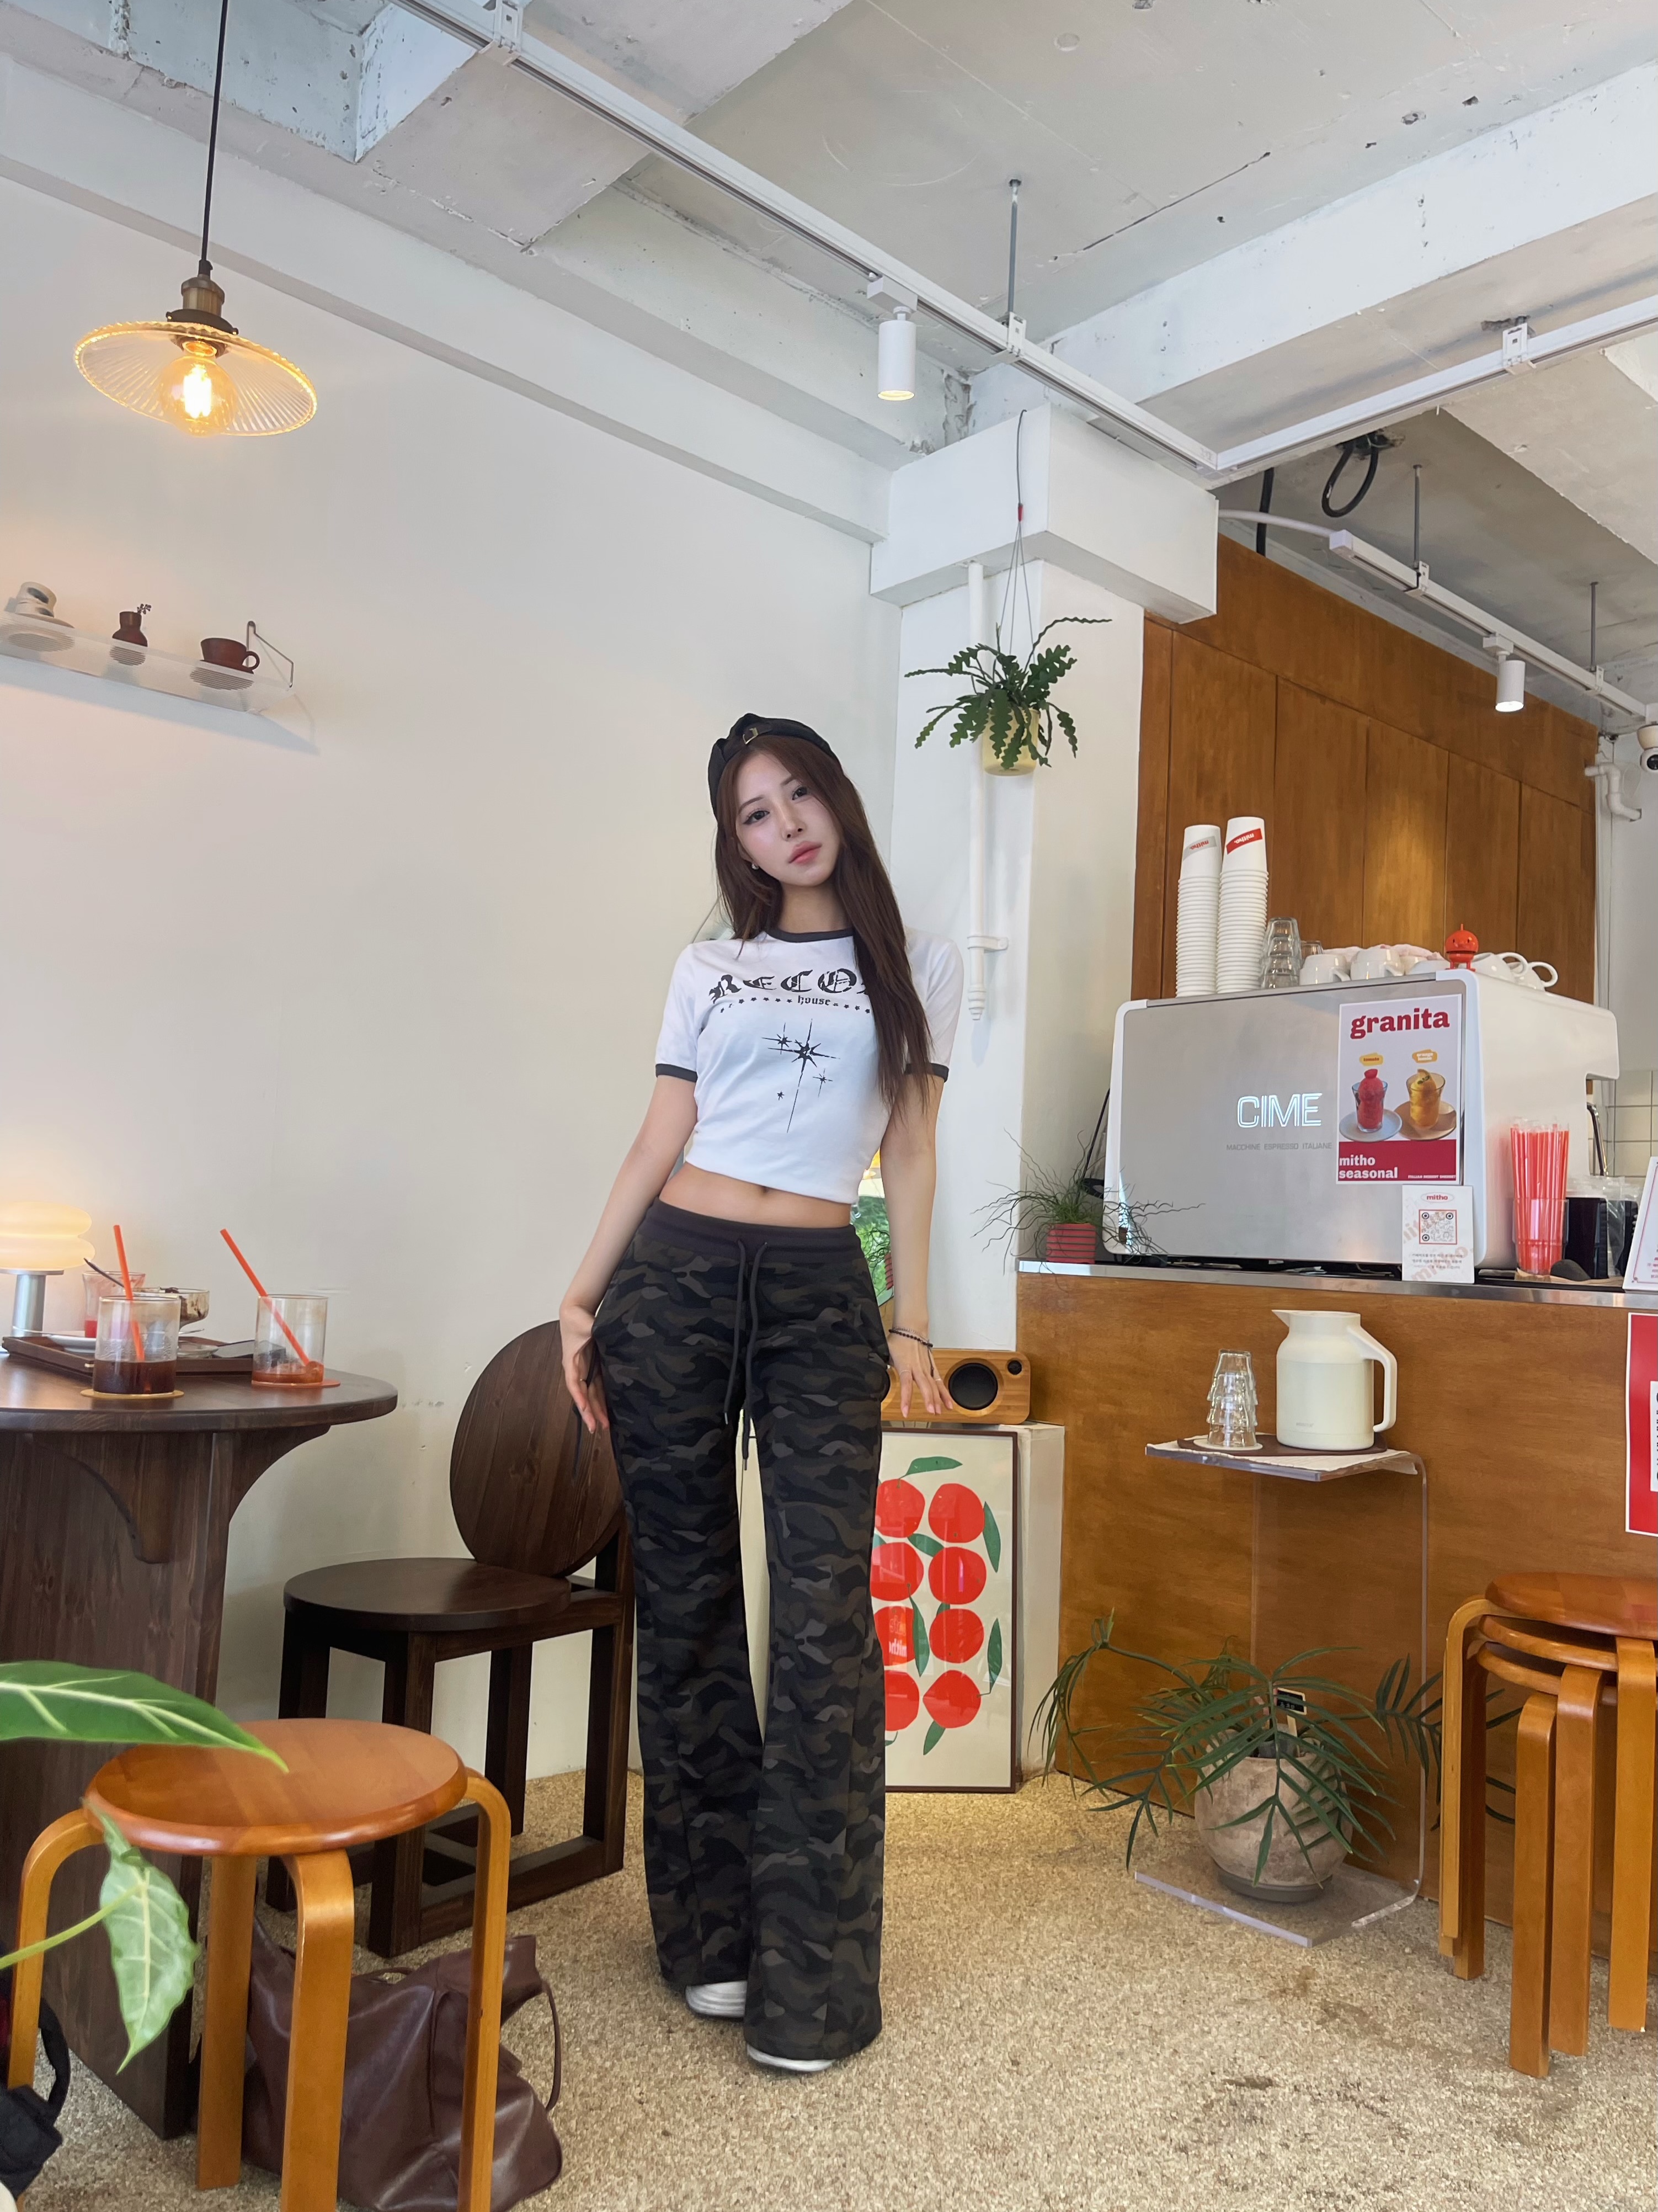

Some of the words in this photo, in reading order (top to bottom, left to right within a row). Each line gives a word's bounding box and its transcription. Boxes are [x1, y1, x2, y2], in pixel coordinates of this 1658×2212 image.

[708, 968, 866, 1004] RECO
[798, 995, 831, 1006] house
[1350, 1007, 1451, 1040] granita
[1237, 1093, 1323, 1128] CIME
[1339, 1155, 1376, 1166] mitho
[1339, 1167, 1398, 1179] seasonal
